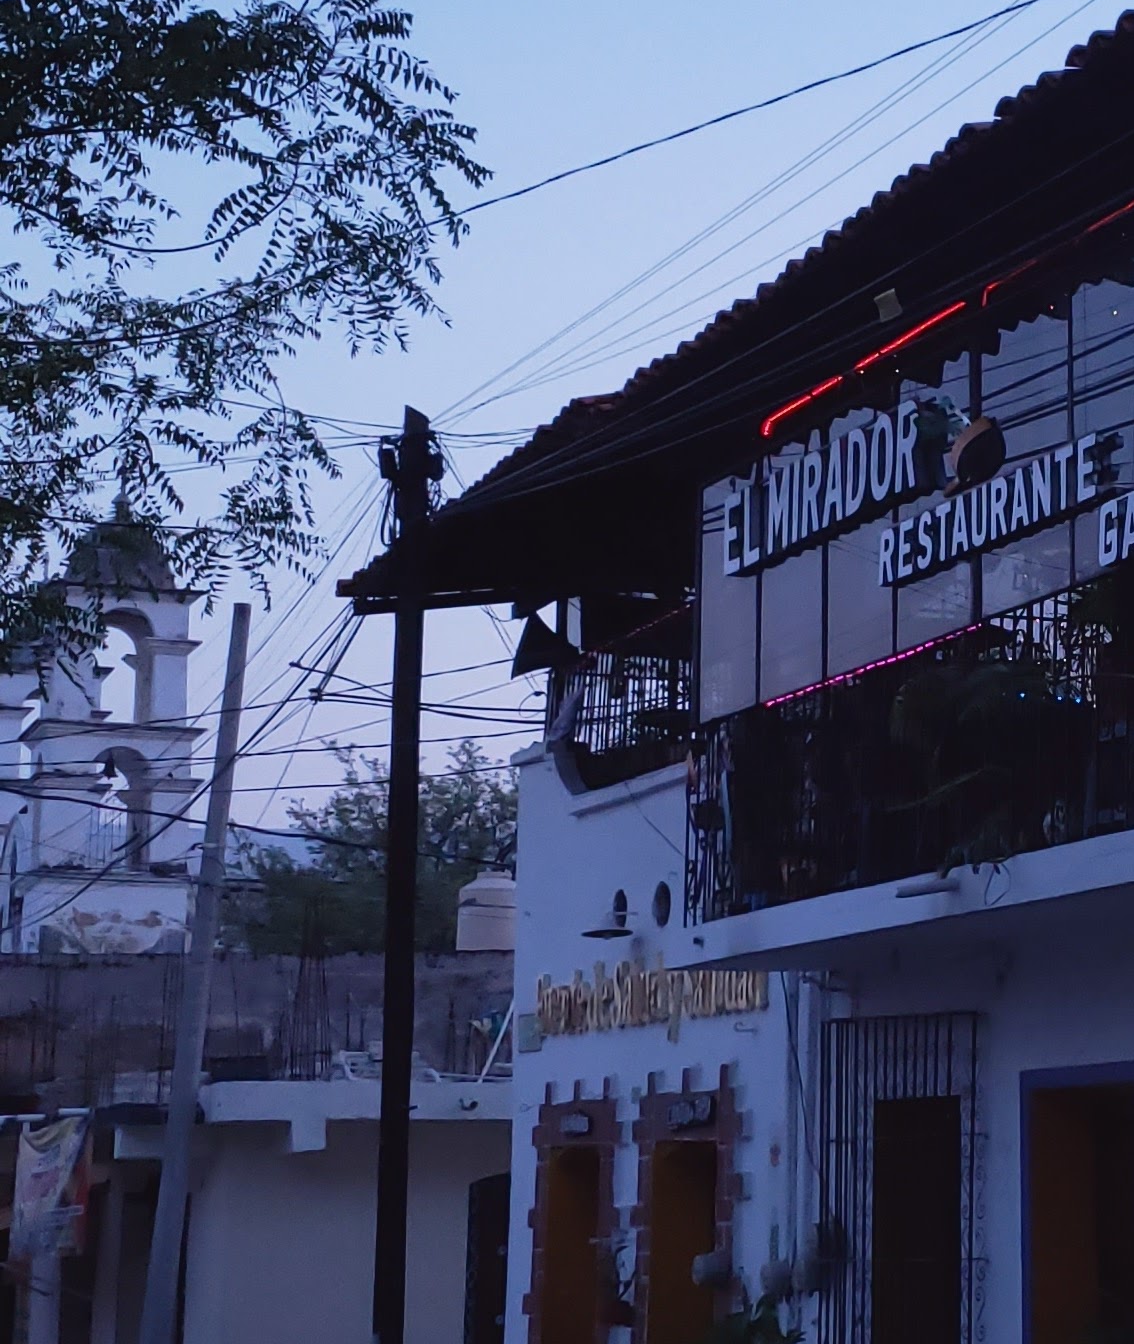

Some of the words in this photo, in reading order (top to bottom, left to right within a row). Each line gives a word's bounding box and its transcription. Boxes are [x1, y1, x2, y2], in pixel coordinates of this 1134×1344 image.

[722, 485, 760, 577] EL
[765, 399, 919, 556] MIRADOR
[878, 432, 1098, 587] RESTAURANTE
